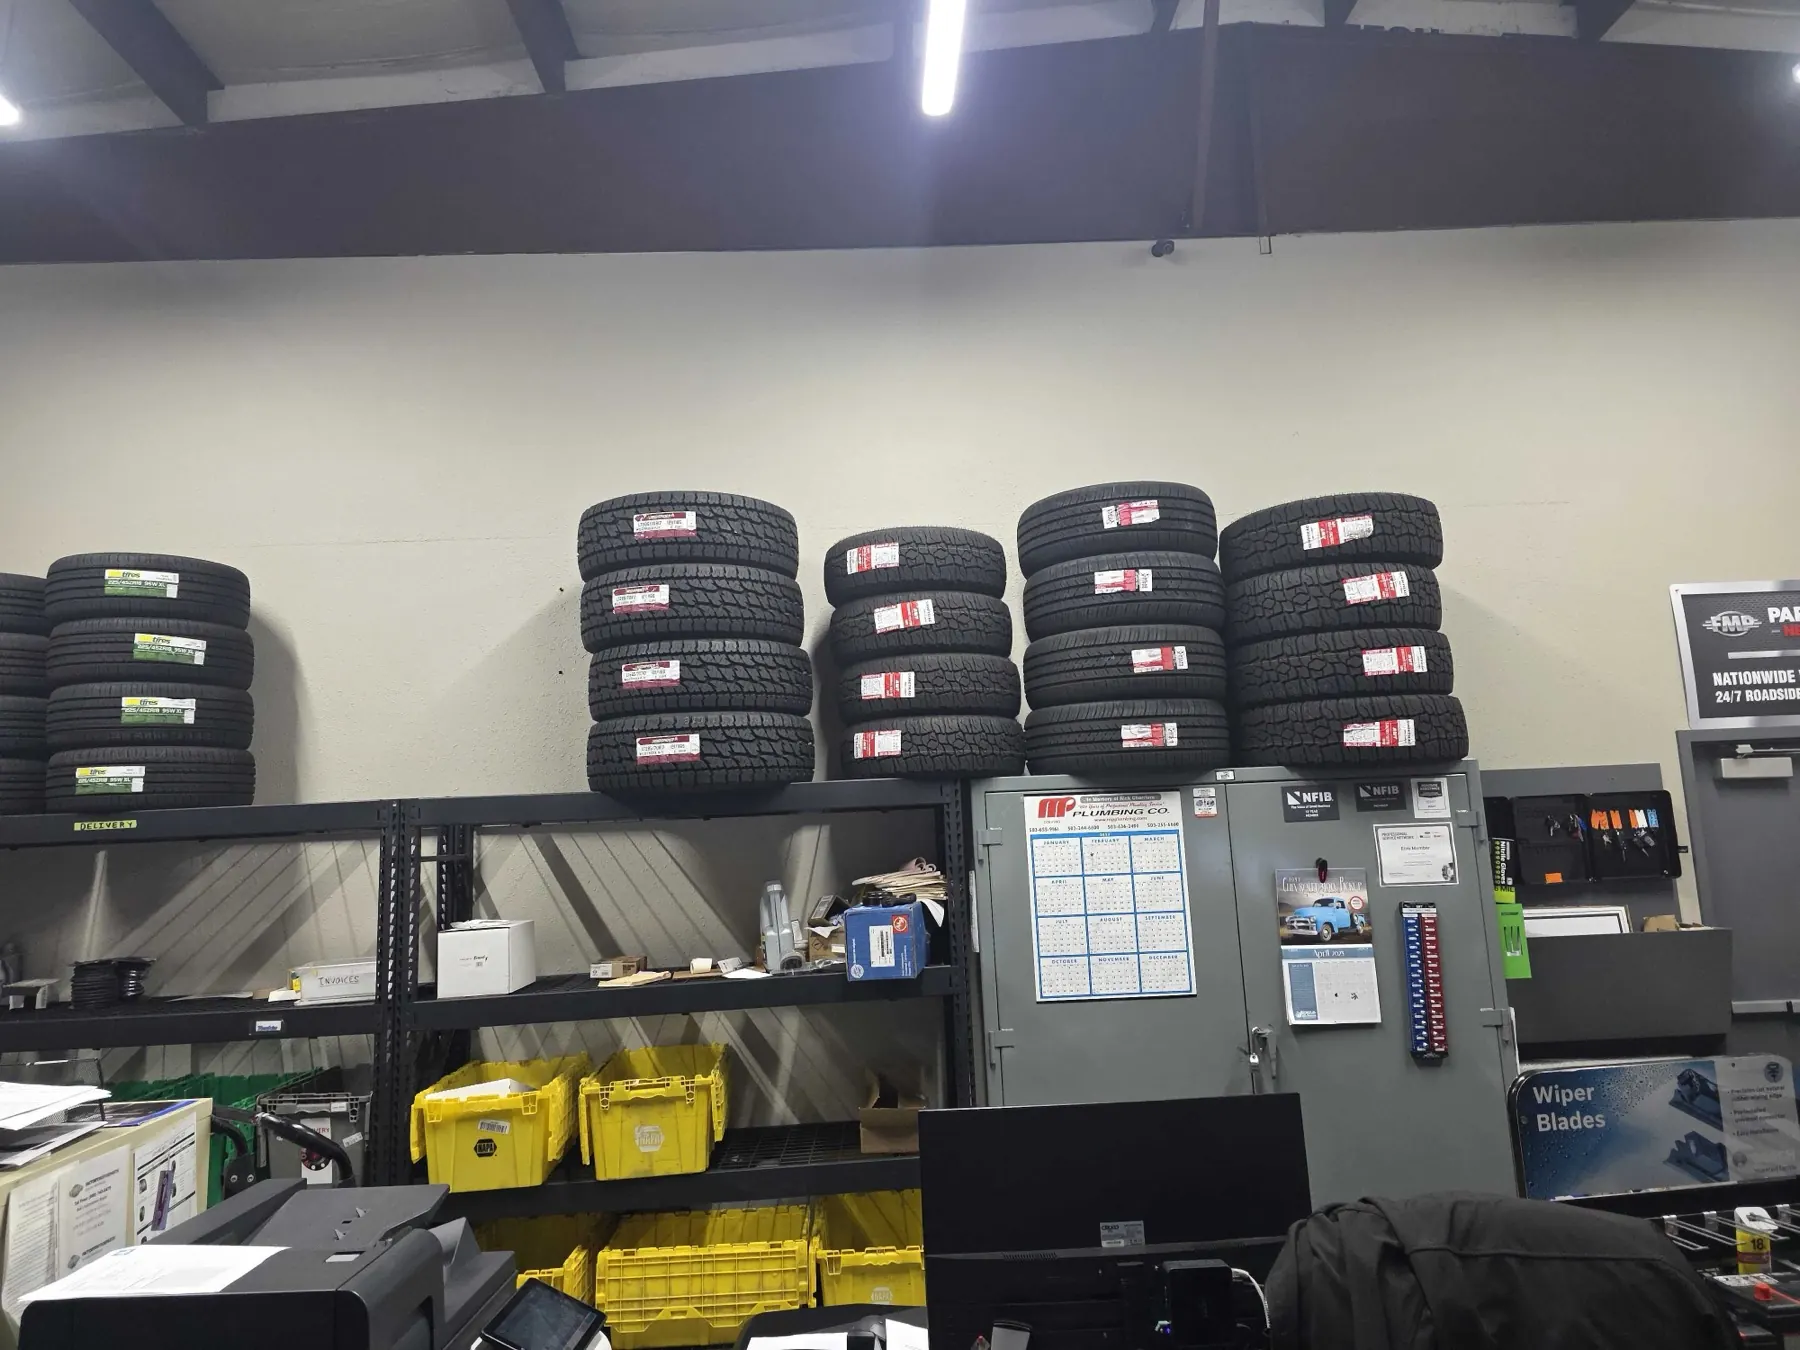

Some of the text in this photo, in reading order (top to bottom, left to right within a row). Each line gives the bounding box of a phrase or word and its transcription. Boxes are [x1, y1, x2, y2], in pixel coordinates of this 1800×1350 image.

[1712, 670, 1796, 686] NATIONWIDE
[1715, 690, 1742, 703] 24/7
[1302, 791, 1332, 803] NFIB
[1372, 786, 1400, 796] NFIB
[1073, 808, 1144, 817] PLUMBING
[80, 820, 133, 830] DELIVERY
[318, 976, 360, 986] INVOICES
[1532, 1084, 1594, 1106] Wiper
[1536, 1110, 1606, 1132] Blades
[1751, 1238, 1764, 1250] 18
